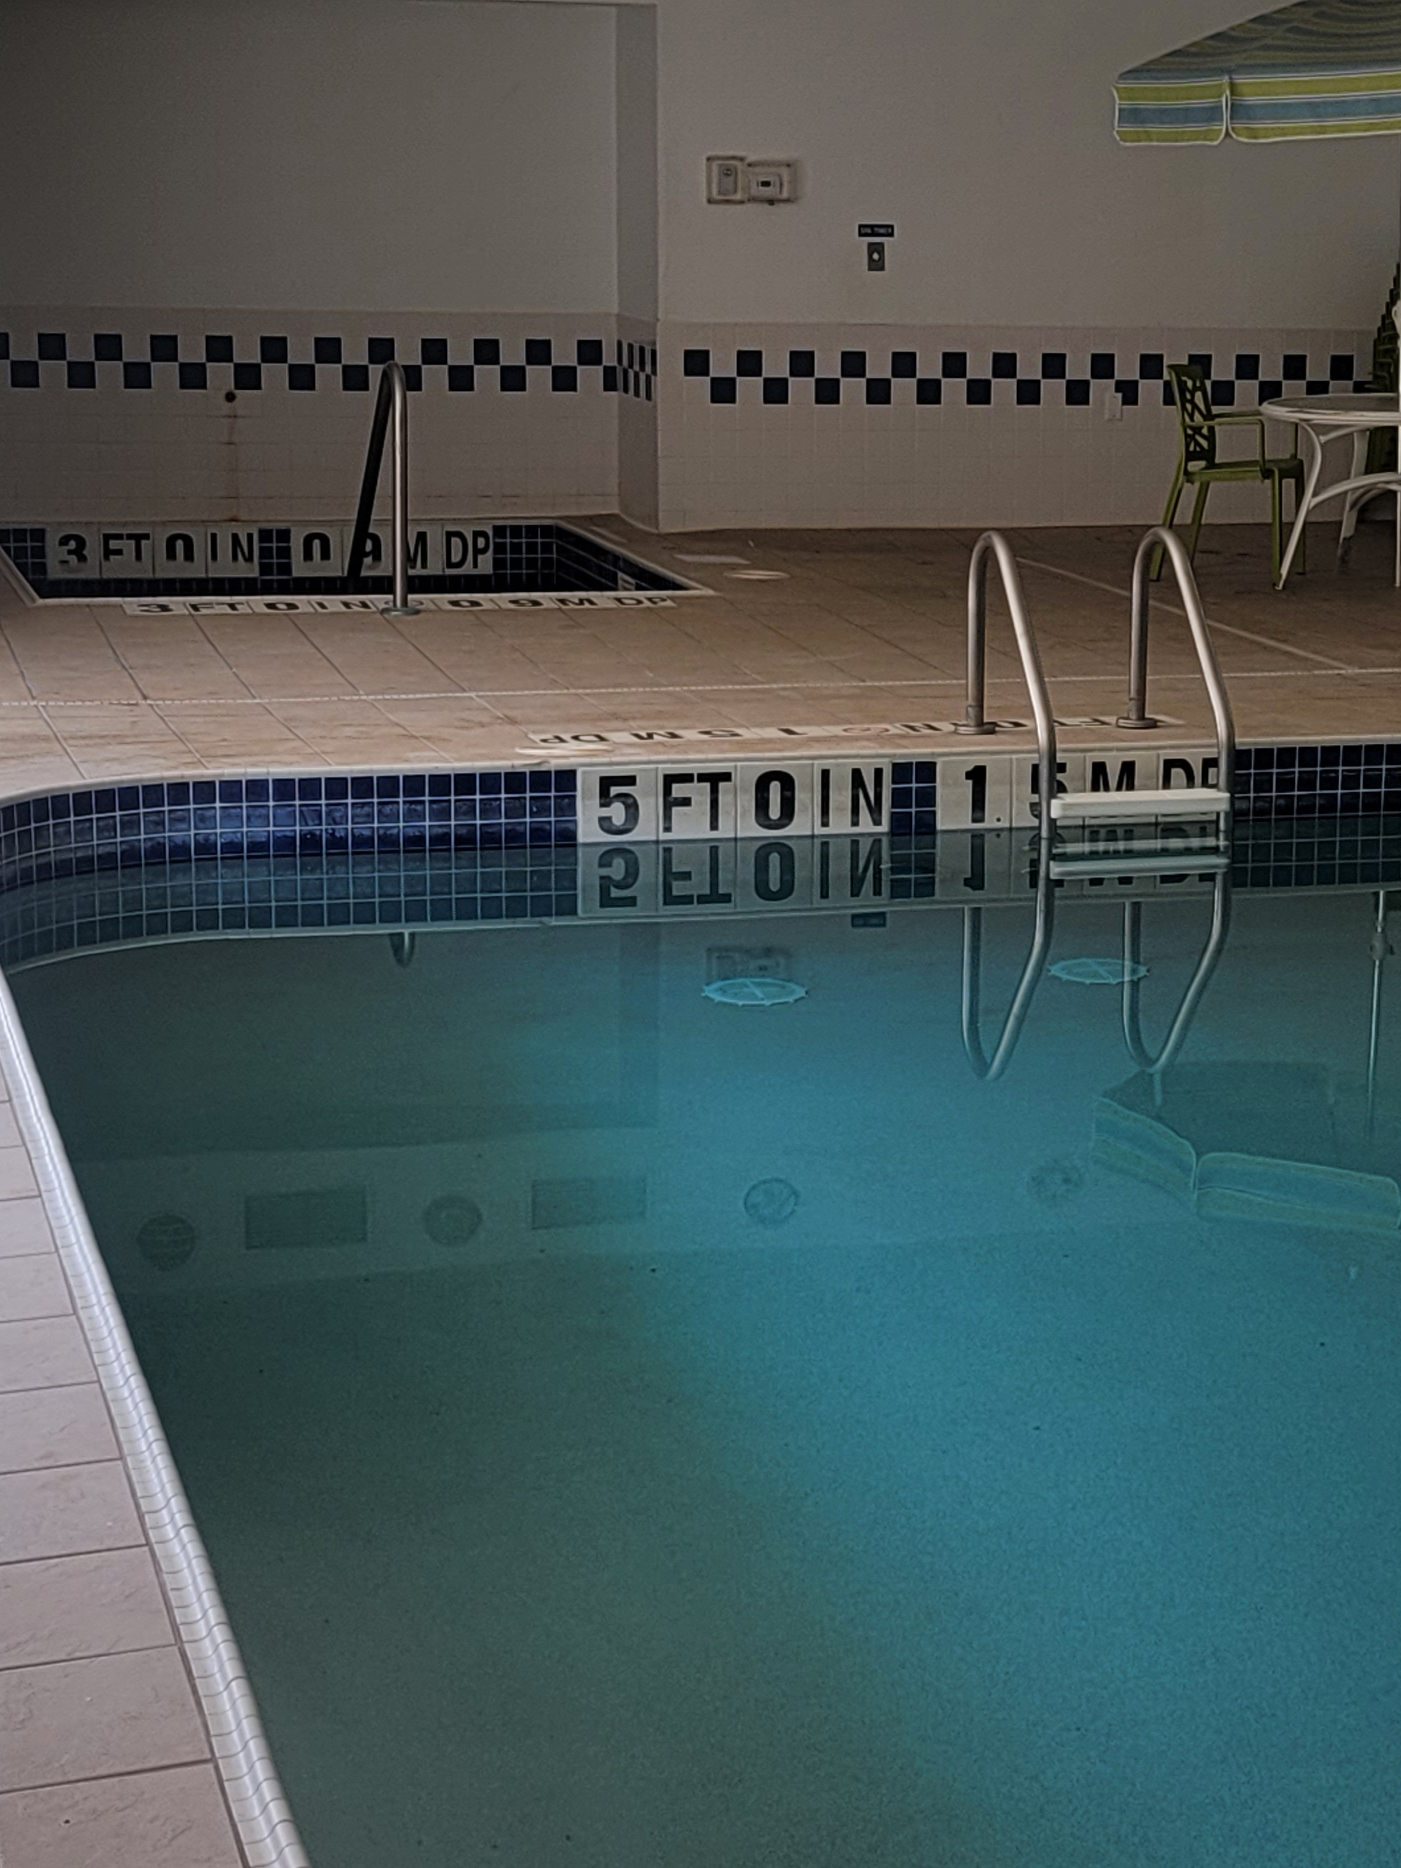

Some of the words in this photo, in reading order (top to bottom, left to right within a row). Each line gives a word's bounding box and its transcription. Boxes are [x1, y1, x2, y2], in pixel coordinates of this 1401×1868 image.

[445, 530, 490, 569] DP
[189, 602, 246, 612] FT
[613, 597, 668, 606] DP
[598, 775, 639, 836] 5
[663, 772, 732, 833] FT
[821, 767, 883, 828] IN
